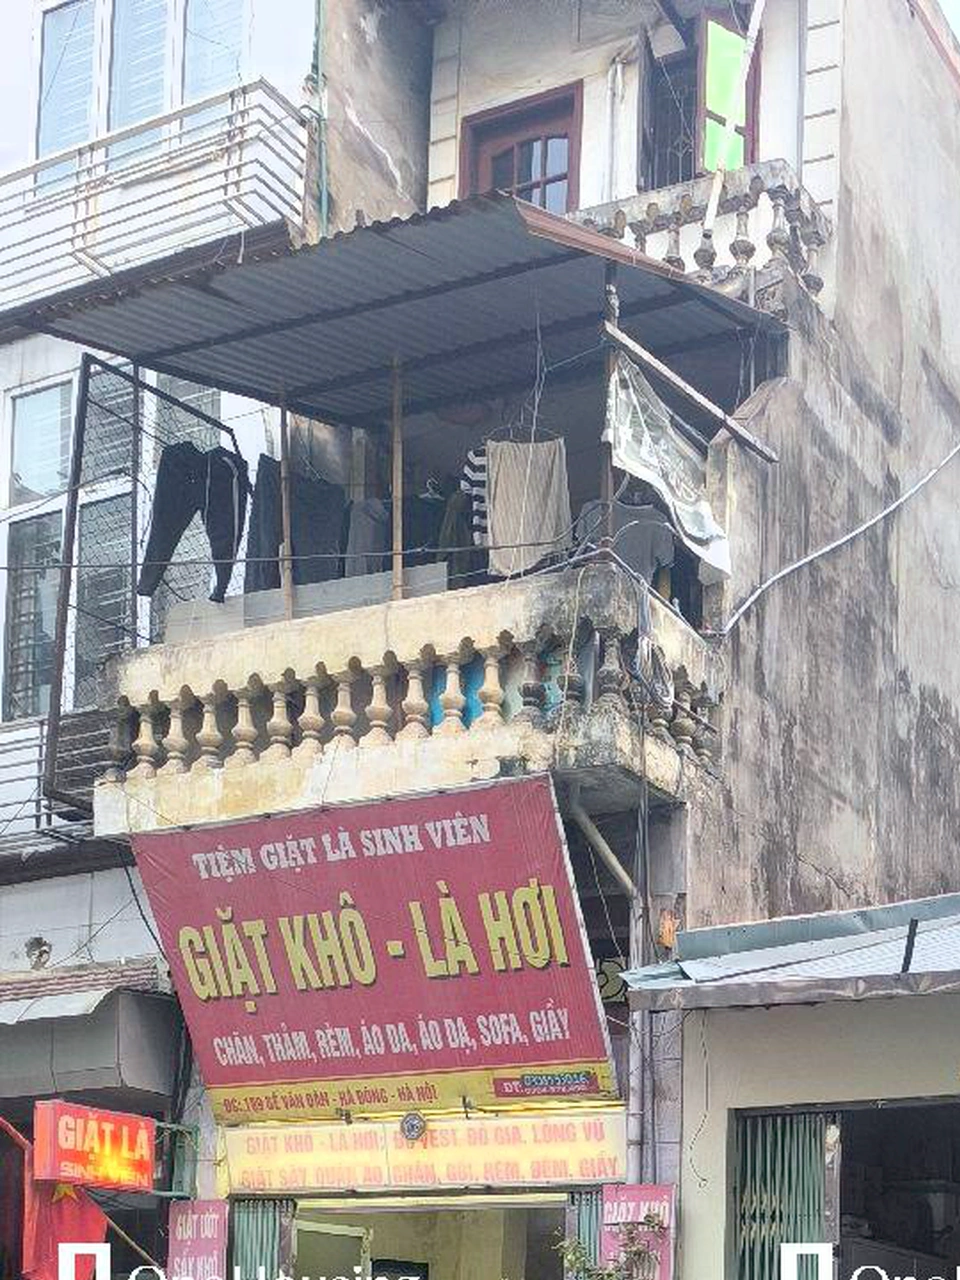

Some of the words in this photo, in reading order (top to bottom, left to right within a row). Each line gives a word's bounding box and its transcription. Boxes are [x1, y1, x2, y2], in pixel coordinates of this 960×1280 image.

[192, 844, 257, 882] TIỆM
[259, 833, 317, 872] GIẶT
[322, 826, 356, 861] LÀ
[360, 823, 424, 858] SINH
[425, 811, 492, 849] VIÊN
[179, 906, 278, 1012] GIẶT
[279, 891, 377, 991] KHÔ
[386, 940, 406, 960] -
[408, 880, 480, 977] LÀ
[478, 878, 569, 970] HƠI
[361, 1018, 385, 1056] ÁO
[418, 1013, 443, 1051] ÁO
[58, 1111, 114, 1161] GIẶT
[120, 1119, 150, 1161] LÀ
